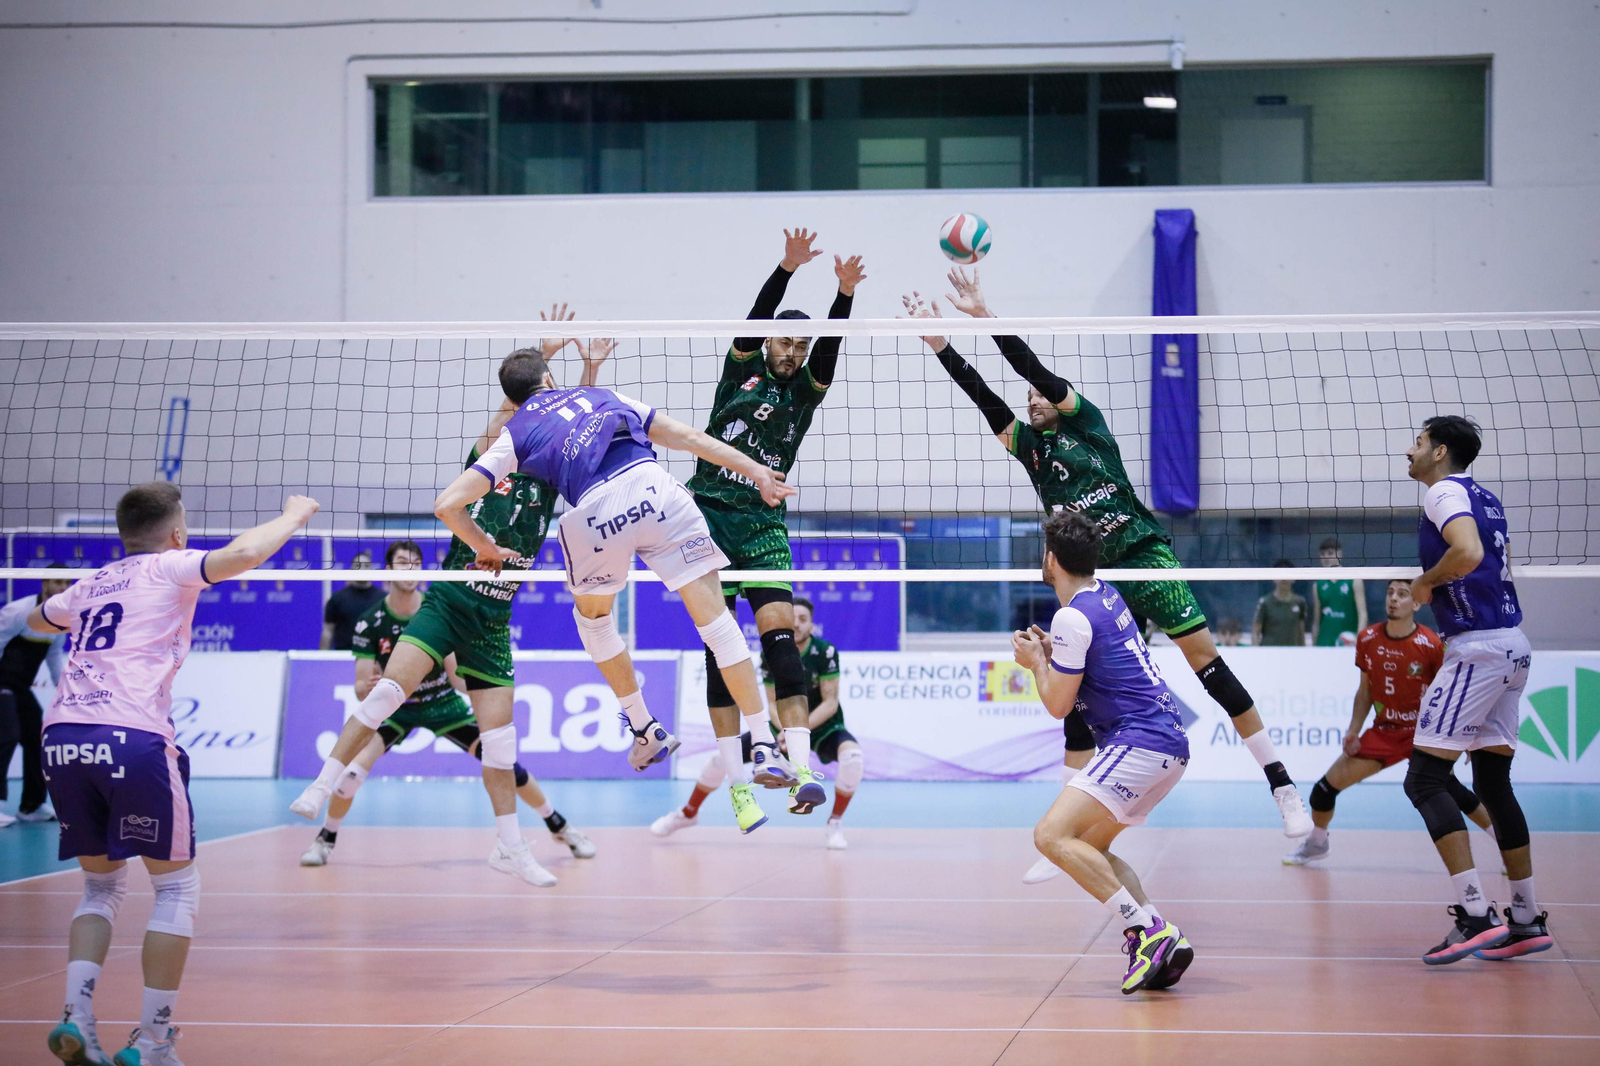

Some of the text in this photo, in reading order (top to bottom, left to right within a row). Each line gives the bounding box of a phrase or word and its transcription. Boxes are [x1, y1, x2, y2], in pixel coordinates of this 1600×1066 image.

[753, 403, 774, 420] 8
[1052, 461, 1069, 481] 3
[1066, 482, 1117, 513] Unicaja
[595, 500, 656, 540] TIPSA
[72, 602, 124, 656] 18
[857, 665, 972, 681] VIOLENCIA
[849, 681, 972, 700] DE GÉNERO
[1385, 676, 1395, 695] 5
[1428, 687, 1443, 708] 2
[316, 682, 634, 761] Jma
[44, 743, 114, 767] TIPSA
